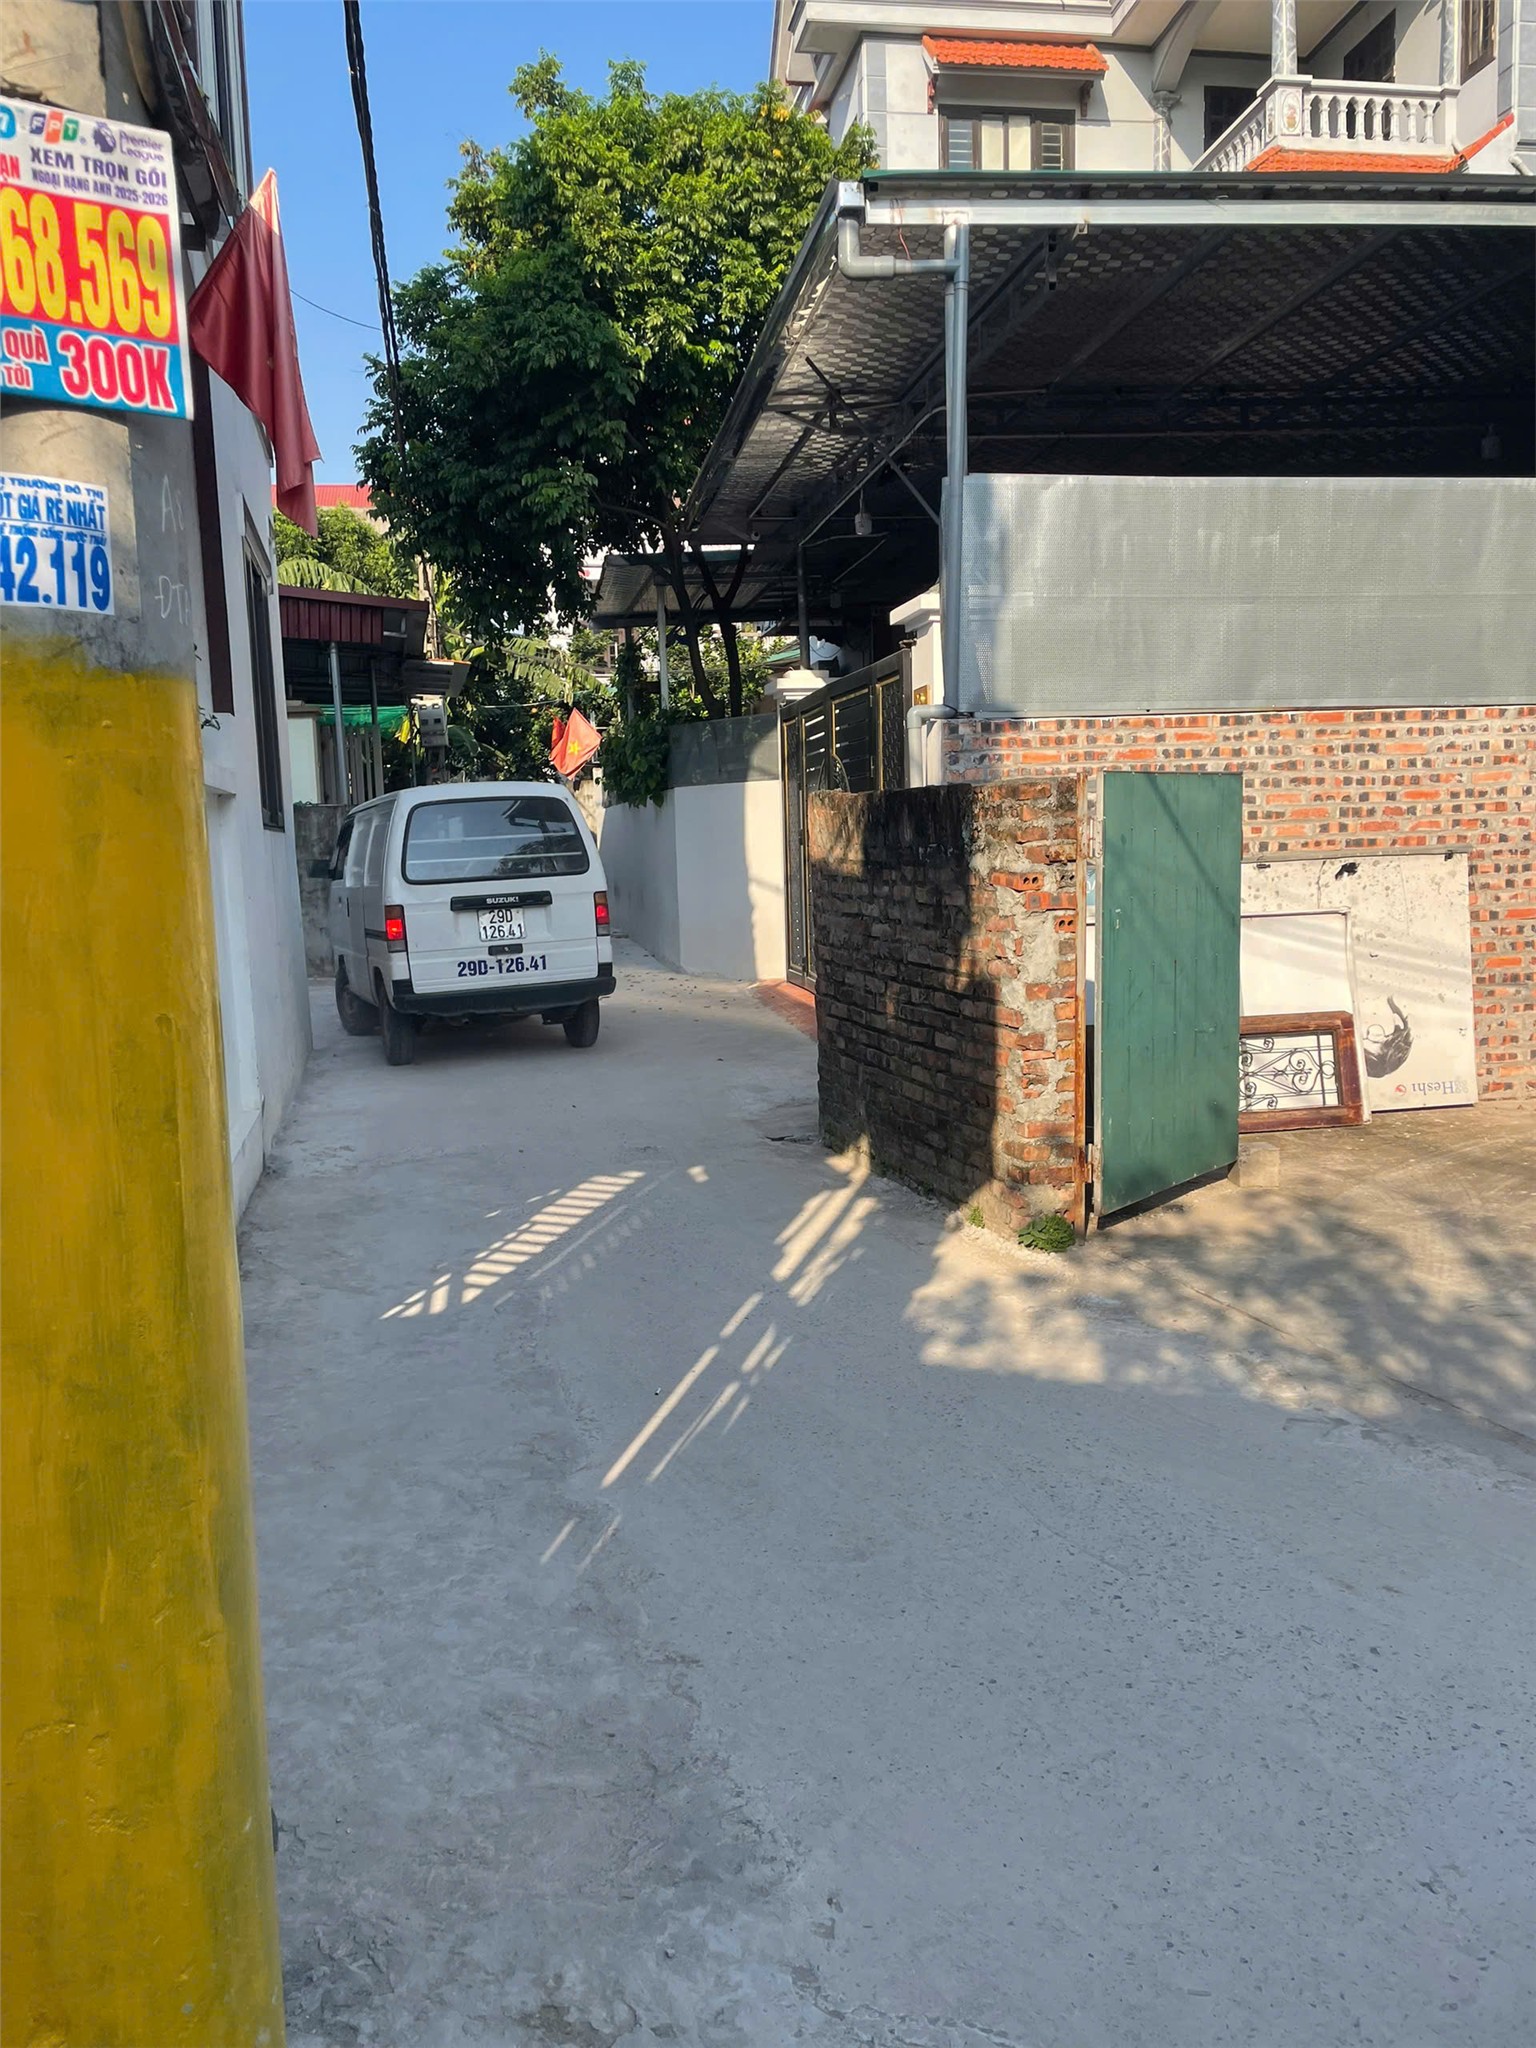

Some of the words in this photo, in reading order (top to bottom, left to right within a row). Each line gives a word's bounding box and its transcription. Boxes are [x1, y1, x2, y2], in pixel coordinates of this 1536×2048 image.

[29, 111, 79, 143] FPT
[119, 130, 164, 151] Premier
[120, 137, 165, 162] League
[30, 146, 74, 171] XEM
[80, 155, 129, 182] TRỌN
[136, 166, 167, 188] GÓI
[63, 175, 90, 194] HẠNG
[93, 182, 112, 197] ANH
[115, 185, 168, 207] 2025-2026
[3, 362, 32, 389] TỚI
[4, 326, 49, 363] QUÀ
[57, 333, 175, 410] 300K
[46, 493, 64, 524] RẺ
[67, 500, 105, 530] NHẤT
[0, 536, 110, 611] 42.119
[486, 896, 519, 904] SUZUKI
[489, 909, 513, 924] 29D
[482, 924, 523, 940] 126.41
[457, 955, 547, 977] 29D-126.41
